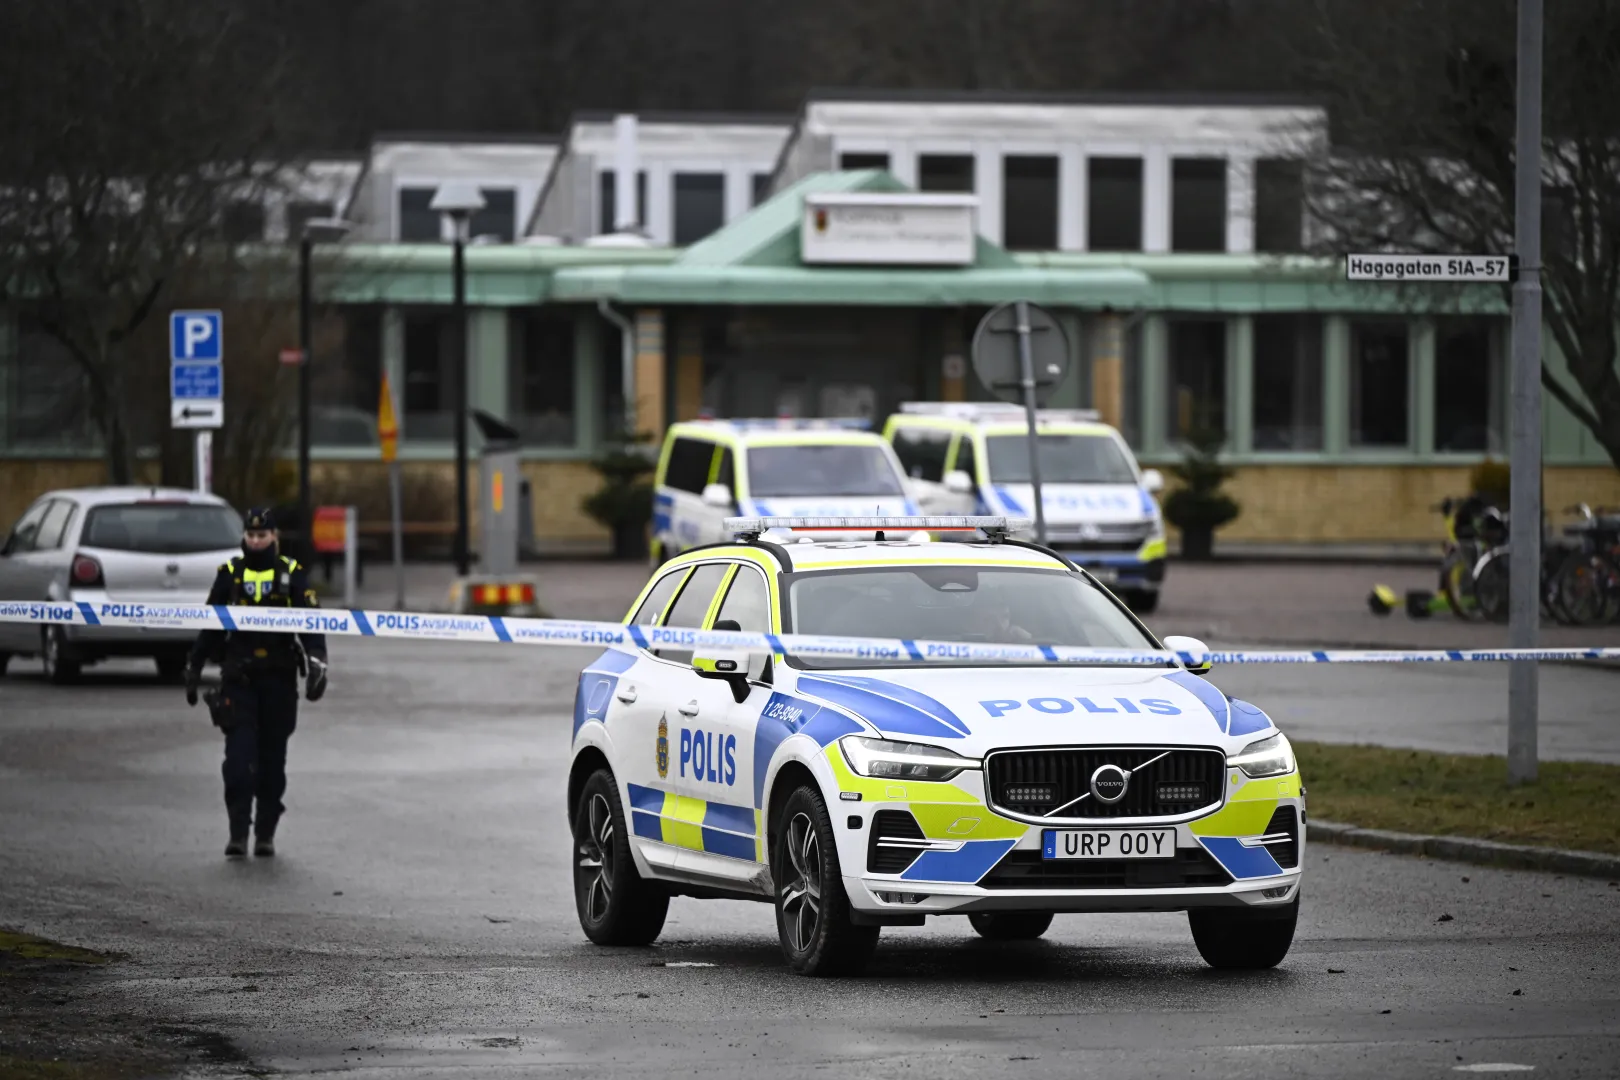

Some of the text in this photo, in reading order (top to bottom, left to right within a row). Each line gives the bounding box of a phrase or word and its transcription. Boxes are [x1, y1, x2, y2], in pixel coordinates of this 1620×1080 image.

[1351, 259, 1442, 278] Hagagatan
[184, 318, 212, 358] P
[30, 606, 73, 620] POLIS
[101, 604, 210, 619] POLIS AVSPÅRRAT
[305, 616, 348, 630] POLIS
[376, 615, 486, 632] POLIS AVSPÅRRAT
[580, 630, 624, 643] POLIS
[652, 629, 696, 644] POLIS
[927, 644, 970, 658] POLIS
[1202, 652, 1244, 663] POLIS
[768, 703, 803, 723] 23-9340
[978, 697, 1182, 717] POLIS
[680, 728, 736, 786] POLIS
[1065, 833, 1111, 855] URP
